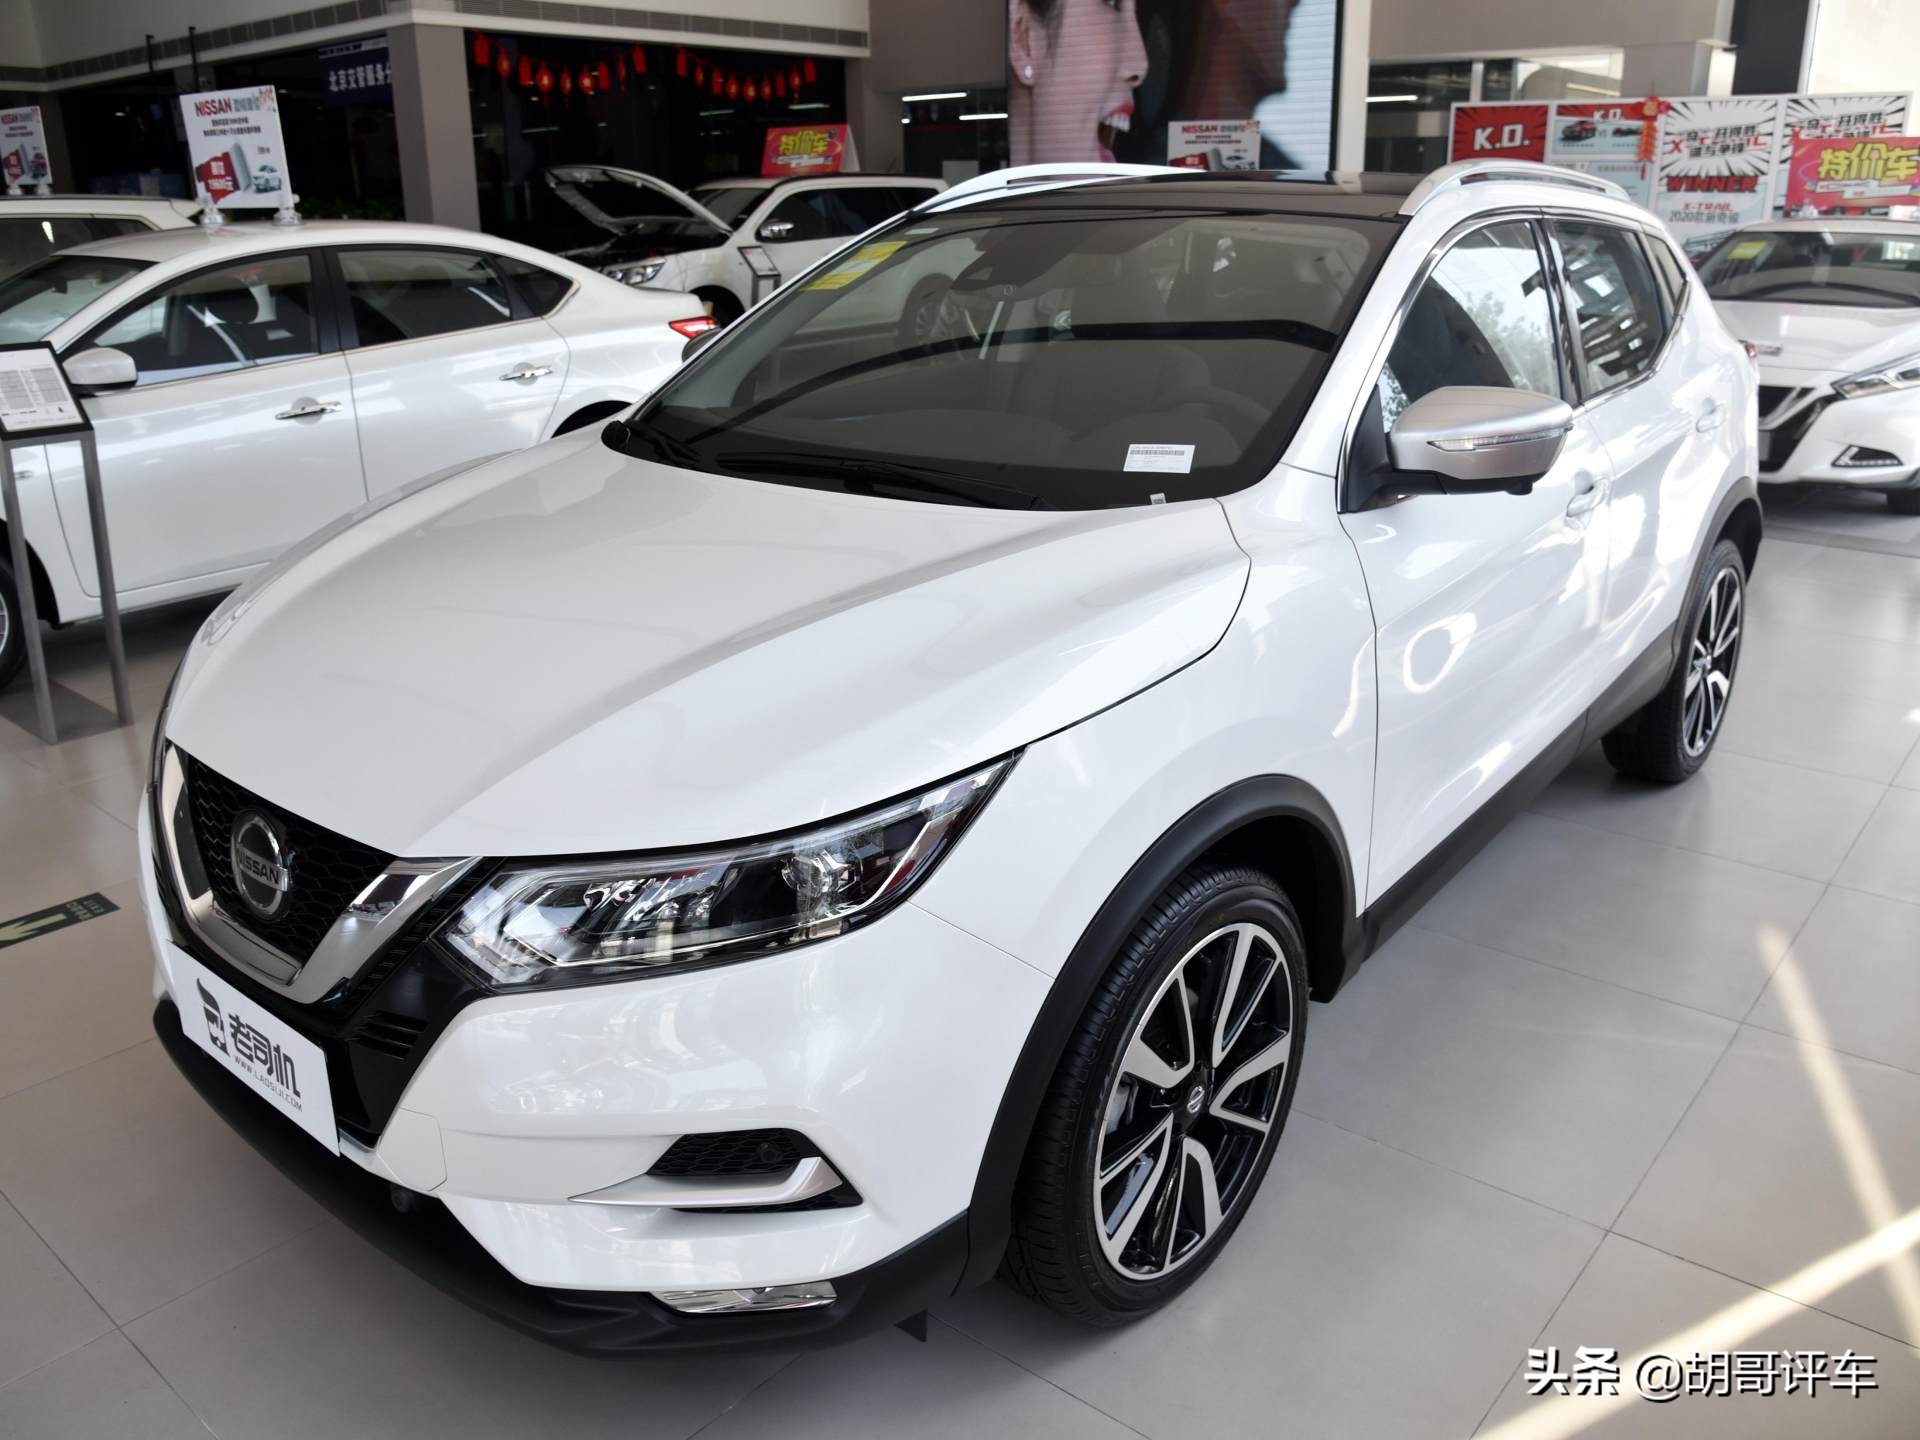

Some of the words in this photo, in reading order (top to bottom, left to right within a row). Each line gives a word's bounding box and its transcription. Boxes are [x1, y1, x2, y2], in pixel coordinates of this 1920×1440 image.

[194, 97, 232, 117] NISSAN
[1182, 124, 1218, 134] NISSAN
[1473, 123, 1530, 151] K.O.
[1818, 142, 1919, 181] 特价车
[1666, 175, 1758, 193] WINNER
[239, 848, 280, 885] NISSAN
[228, 1012, 301, 1099] 老司机
